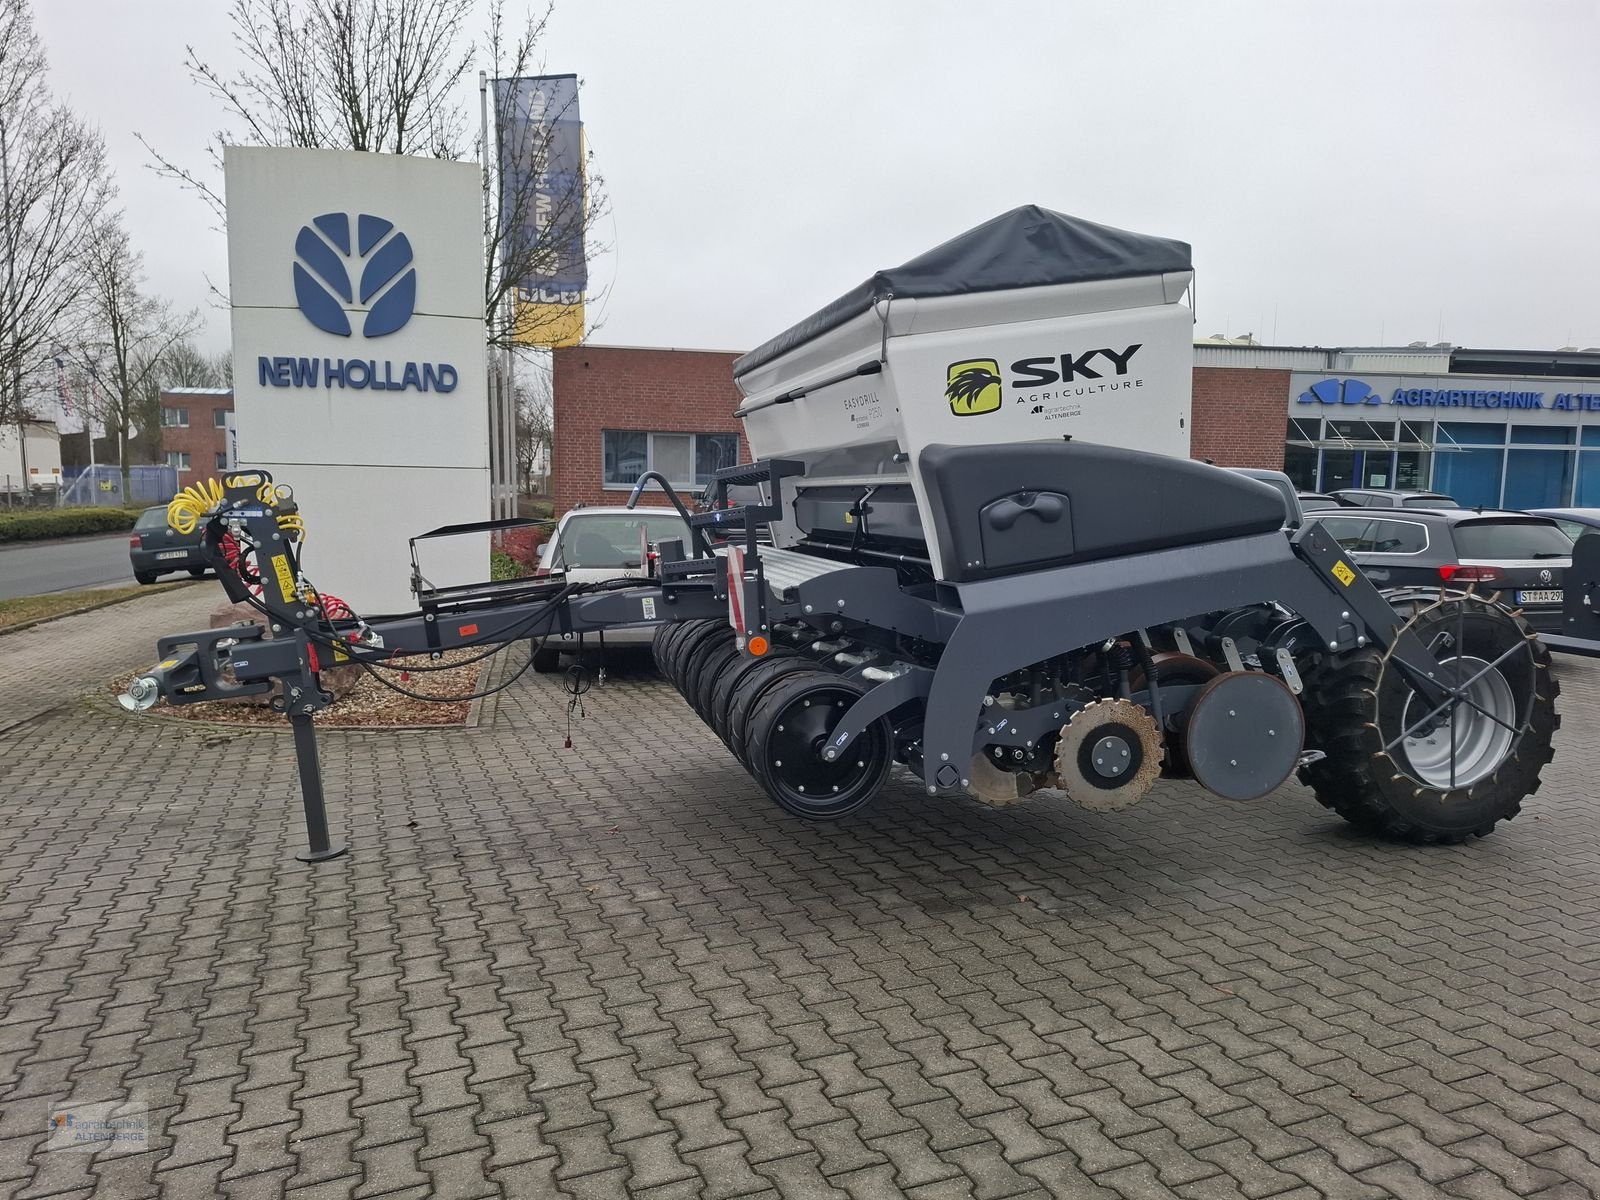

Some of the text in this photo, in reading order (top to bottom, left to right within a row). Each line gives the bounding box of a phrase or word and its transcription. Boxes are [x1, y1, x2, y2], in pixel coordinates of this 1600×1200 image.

[258, 356, 458, 394] NEW HOLLAND
[1010, 343, 1143, 388] SKY
[843, 391, 879, 409] EASYDRILL
[1016, 379, 1144, 404] AGRICULTURE
[1391, 387, 1600, 410] AGRARTECHNIK ALTE
[1521, 591, 1533, 602] ST
